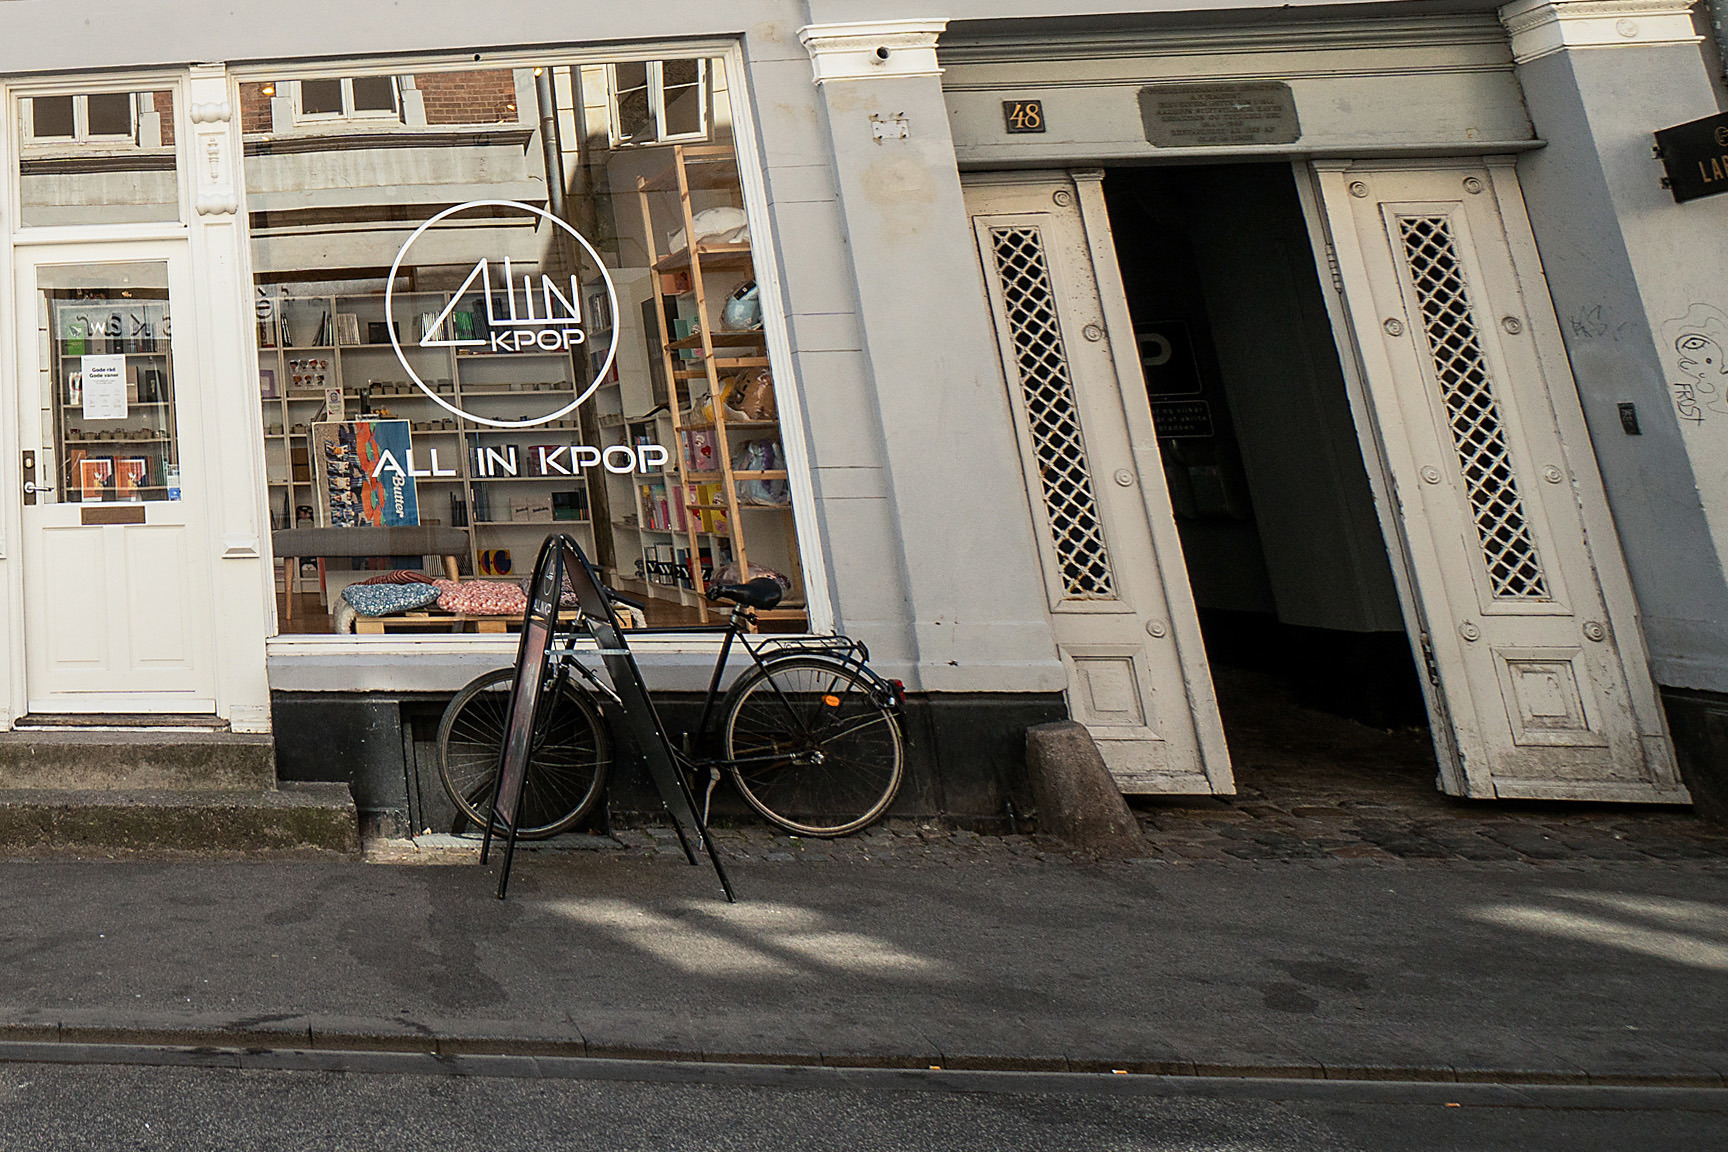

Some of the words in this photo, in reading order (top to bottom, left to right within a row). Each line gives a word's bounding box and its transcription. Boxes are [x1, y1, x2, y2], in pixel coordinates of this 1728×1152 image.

[1010, 103, 1040, 128] 48
[490, 328, 586, 351] KPOP
[1674, 383, 1706, 426] FROST
[372, 448, 456, 477] ALL
[477, 447, 518, 476] IN
[538, 445, 669, 475] KPOP
[392, 471, 406, 518] Butter
